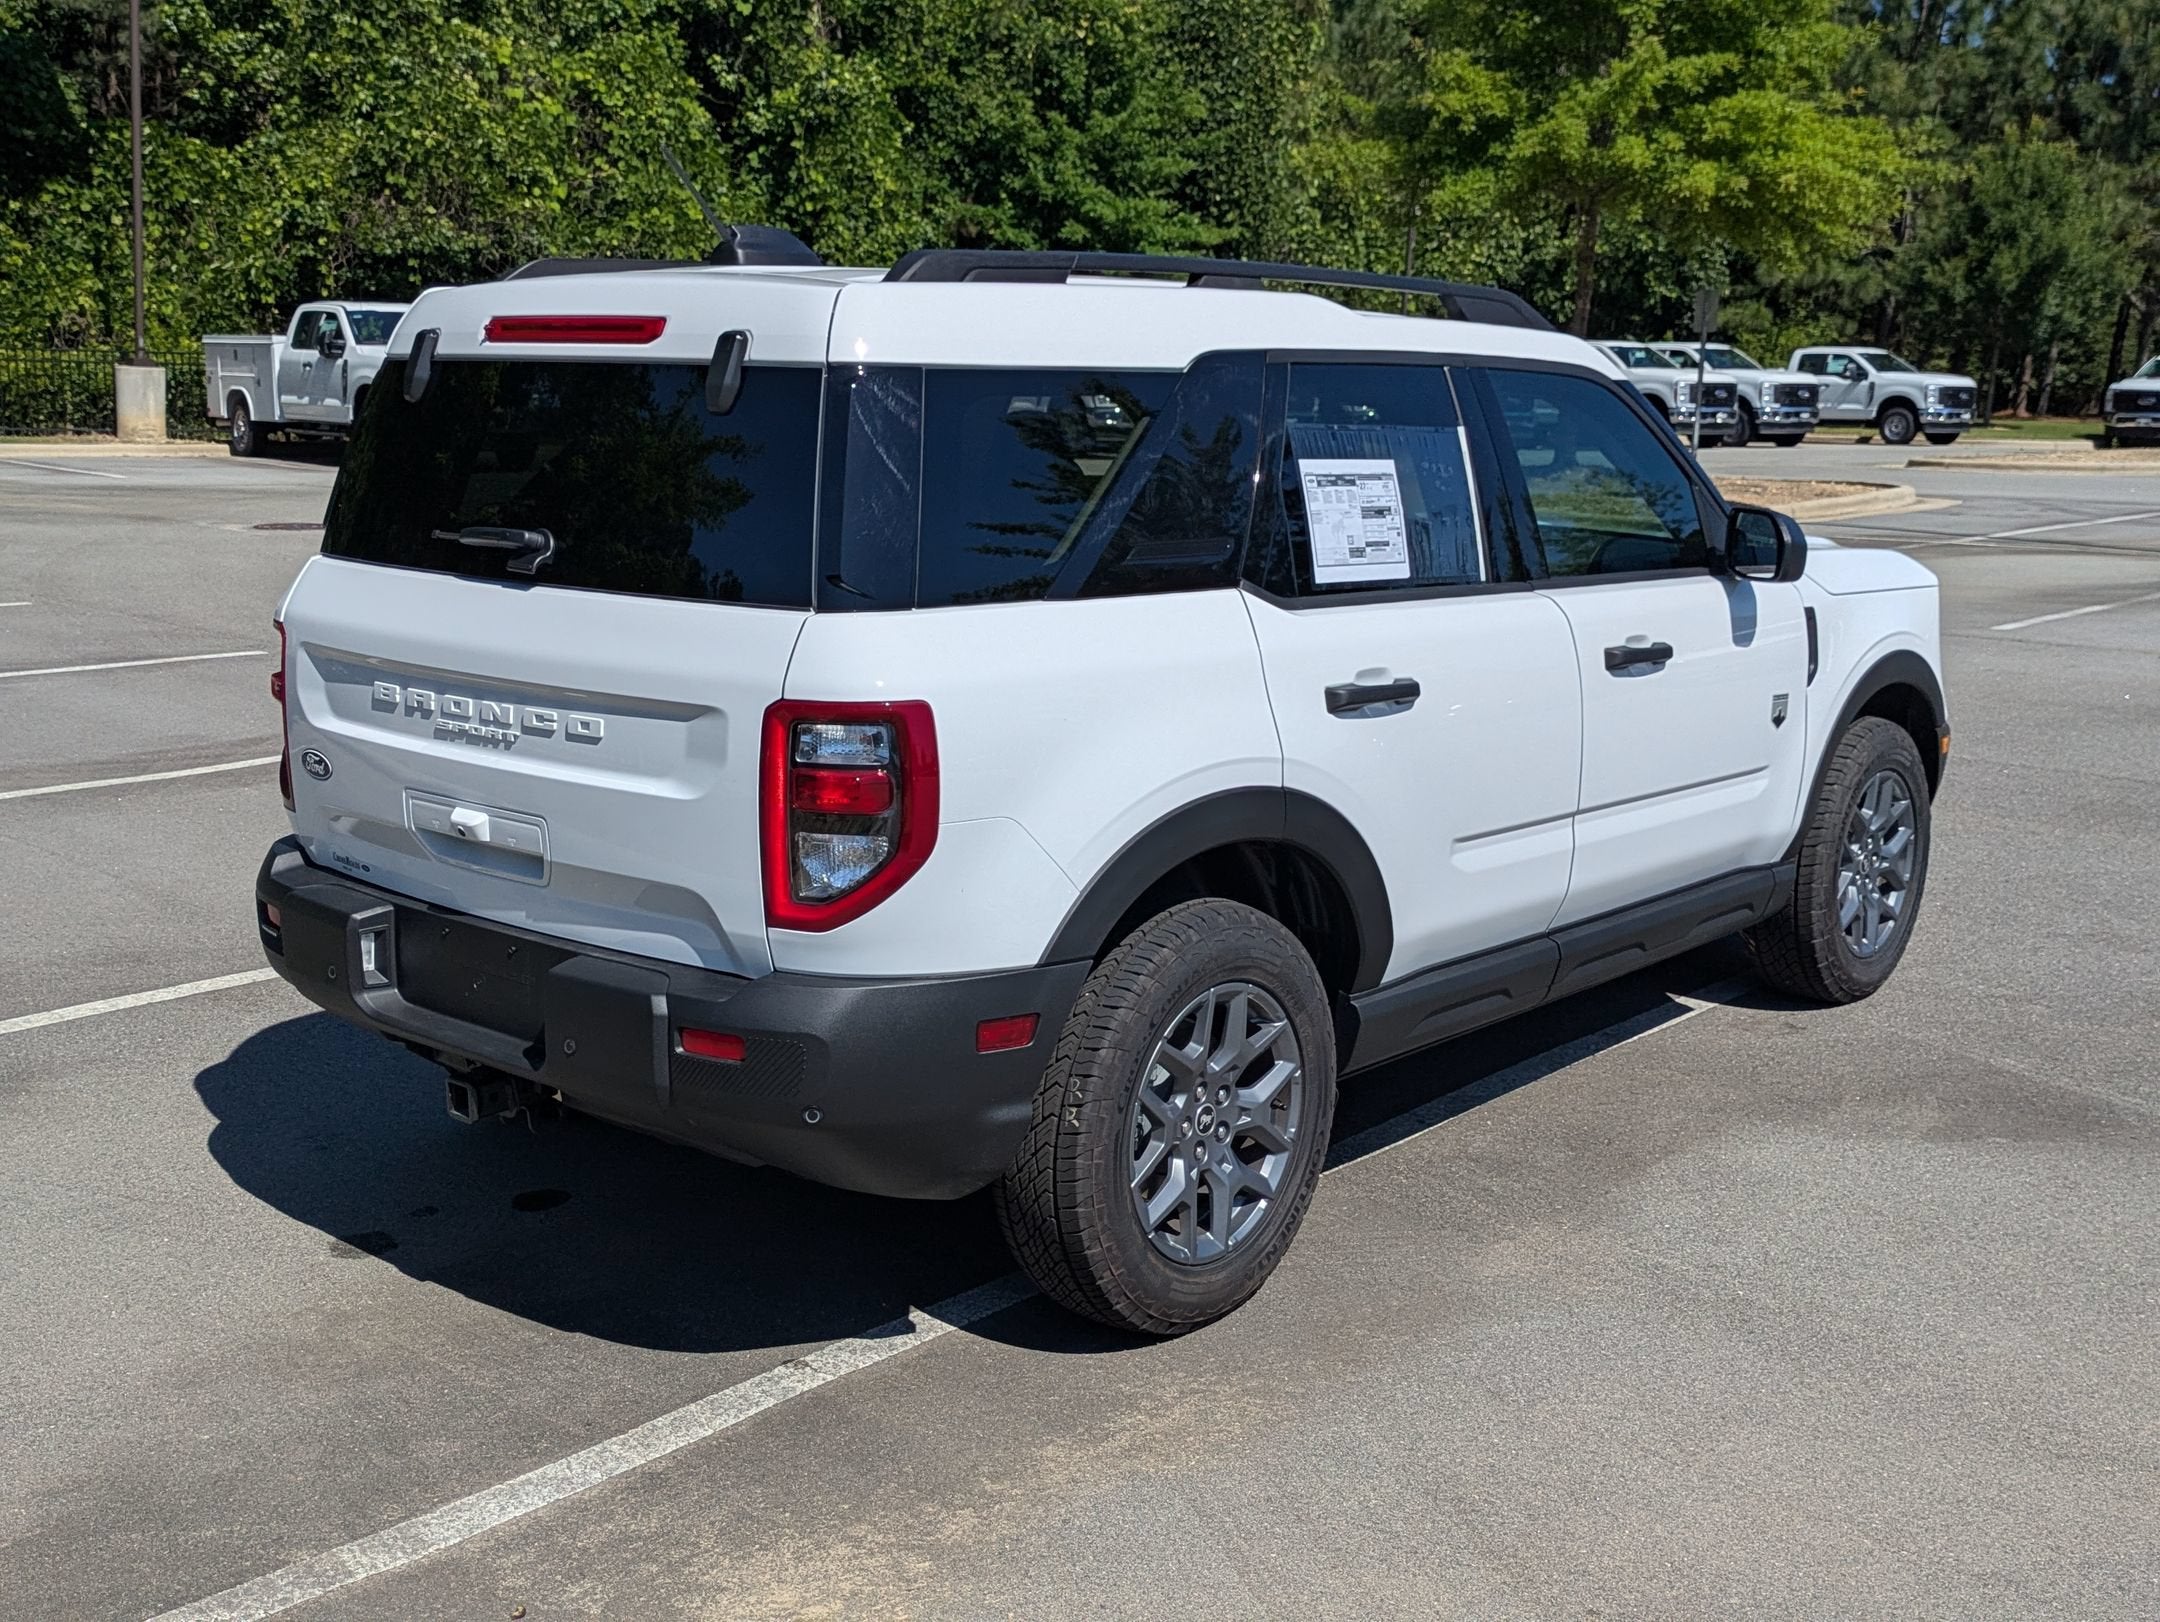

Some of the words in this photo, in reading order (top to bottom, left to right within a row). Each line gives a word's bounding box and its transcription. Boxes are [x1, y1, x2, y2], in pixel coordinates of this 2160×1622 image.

[372, 681, 605, 738] BRONCO
[436, 718, 520, 742] SPORT
[305, 753, 325, 775] Ford
